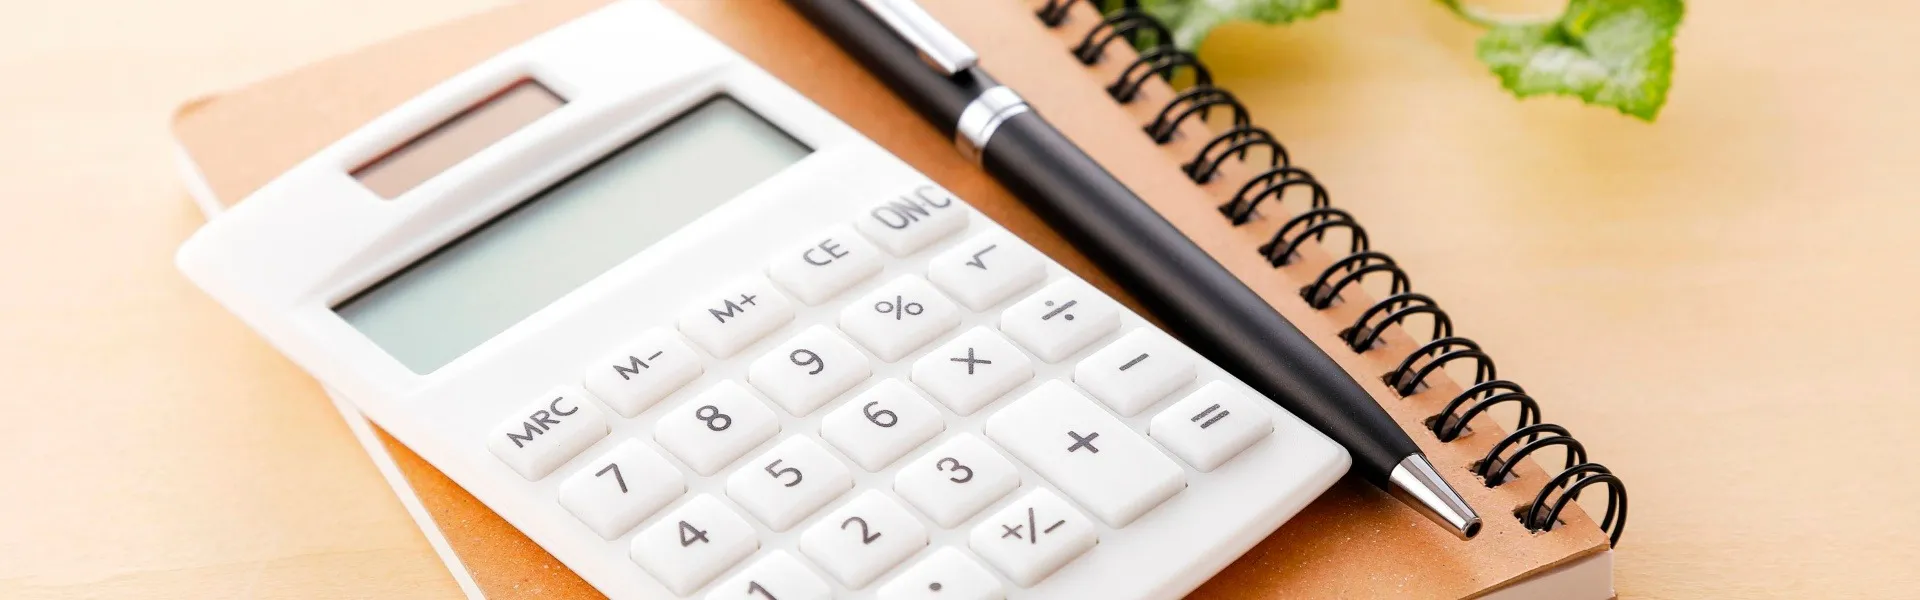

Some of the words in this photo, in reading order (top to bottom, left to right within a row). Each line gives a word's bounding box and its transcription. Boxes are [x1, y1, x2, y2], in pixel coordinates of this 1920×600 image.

[802, 238, 850, 267] CE
[707, 293, 757, 324] M+
[874, 294, 925, 321] %
[789, 348, 825, 376] 9
[506, 396, 579, 449] MRC
[695, 404, 733, 432] 8
[862, 400, 899, 429] 6
[1190, 403, 1231, 430] =
[1066, 430, 1100, 455] +
[594, 462, 629, 494] 7
[764, 458, 803, 488] 5
[935, 456, 974, 484] 3
[678, 520, 710, 548] 4
[840, 516, 882, 546] 2
